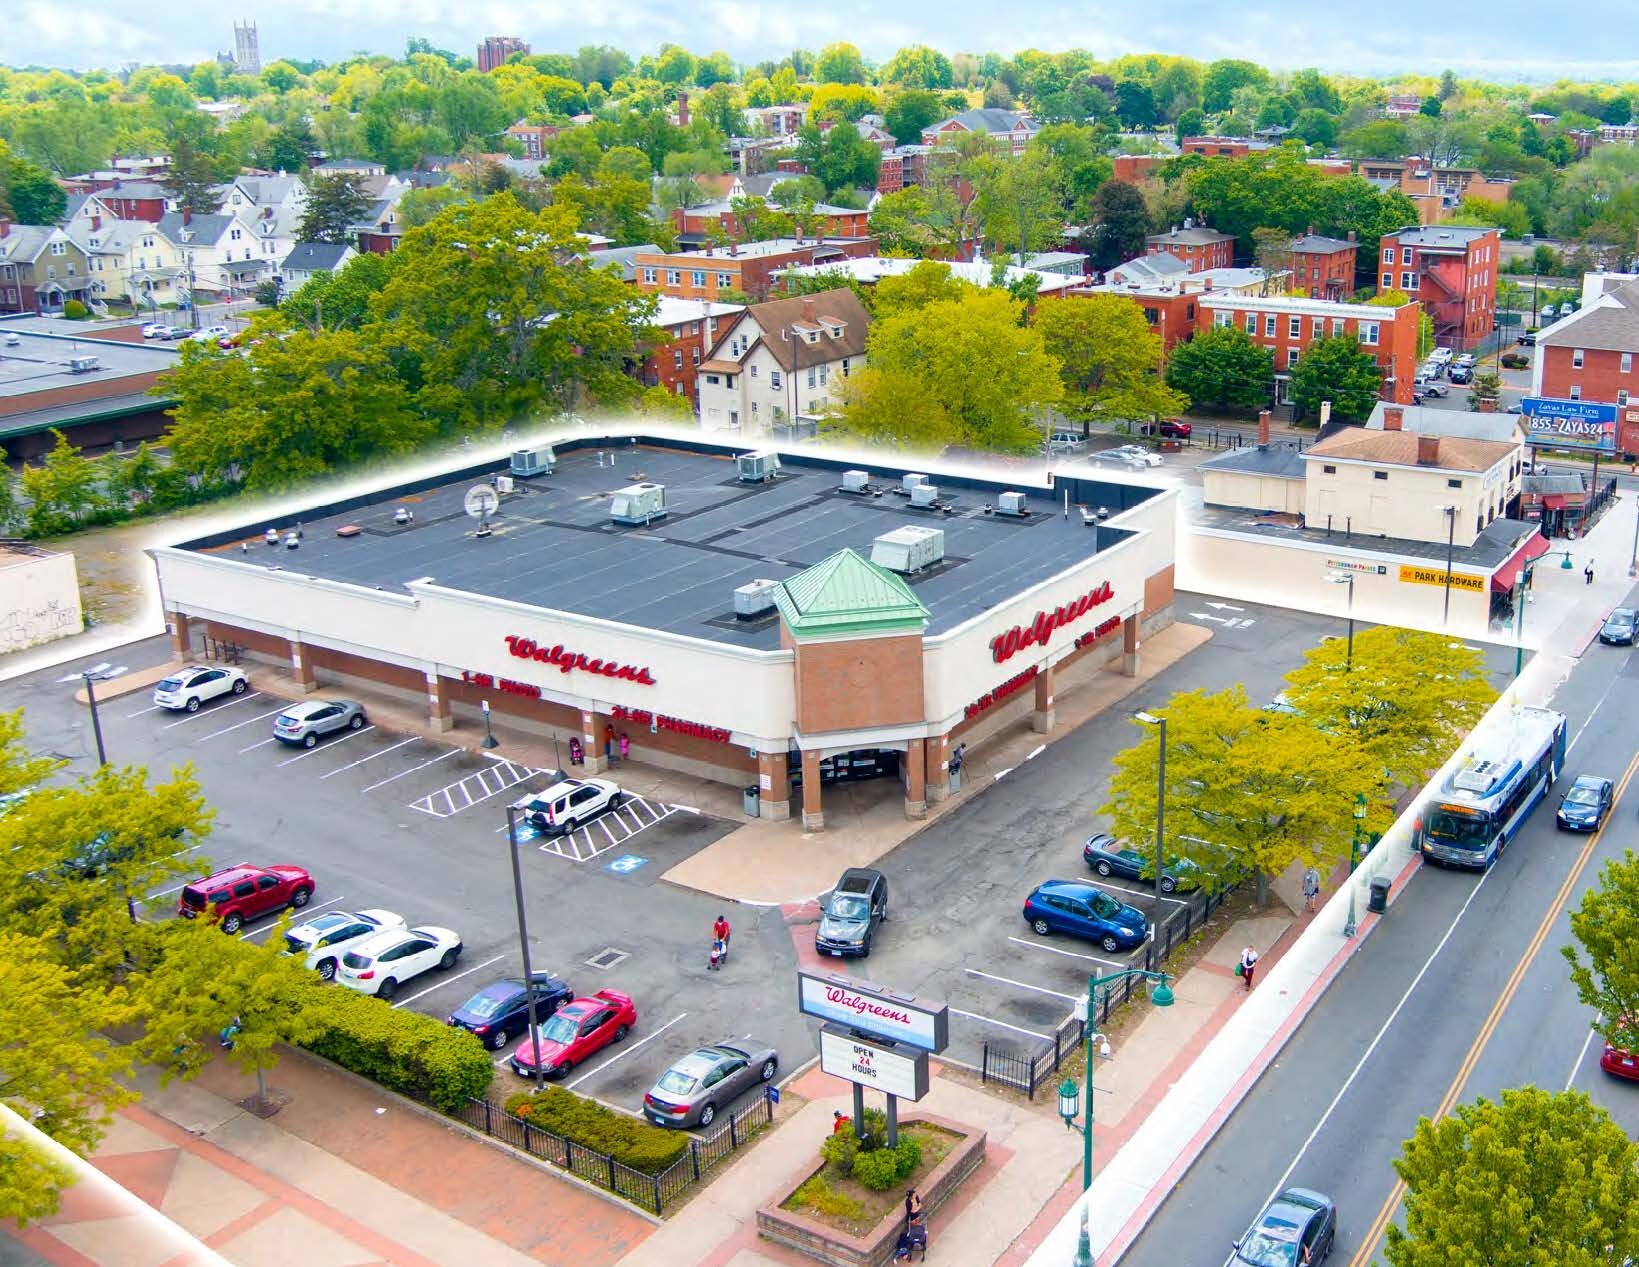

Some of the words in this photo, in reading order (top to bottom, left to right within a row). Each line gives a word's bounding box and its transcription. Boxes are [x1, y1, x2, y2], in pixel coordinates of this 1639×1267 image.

[1561, 404, 1577, 412] Law
[1579, 405, 1599, 415] Firm
[1415, 571, 1436, 583] PARK
[989, 580, 1115, 663] Walgreens
[504, 635, 657, 687] Walgreens
[656, 714, 732, 745] PHARMACY
[825, 986, 911, 1025] Walgreens
[853, 1045, 874, 1059] OPEN
[859, 1056, 870, 1066] 24
[852, 1063, 877, 1078] HOURS
